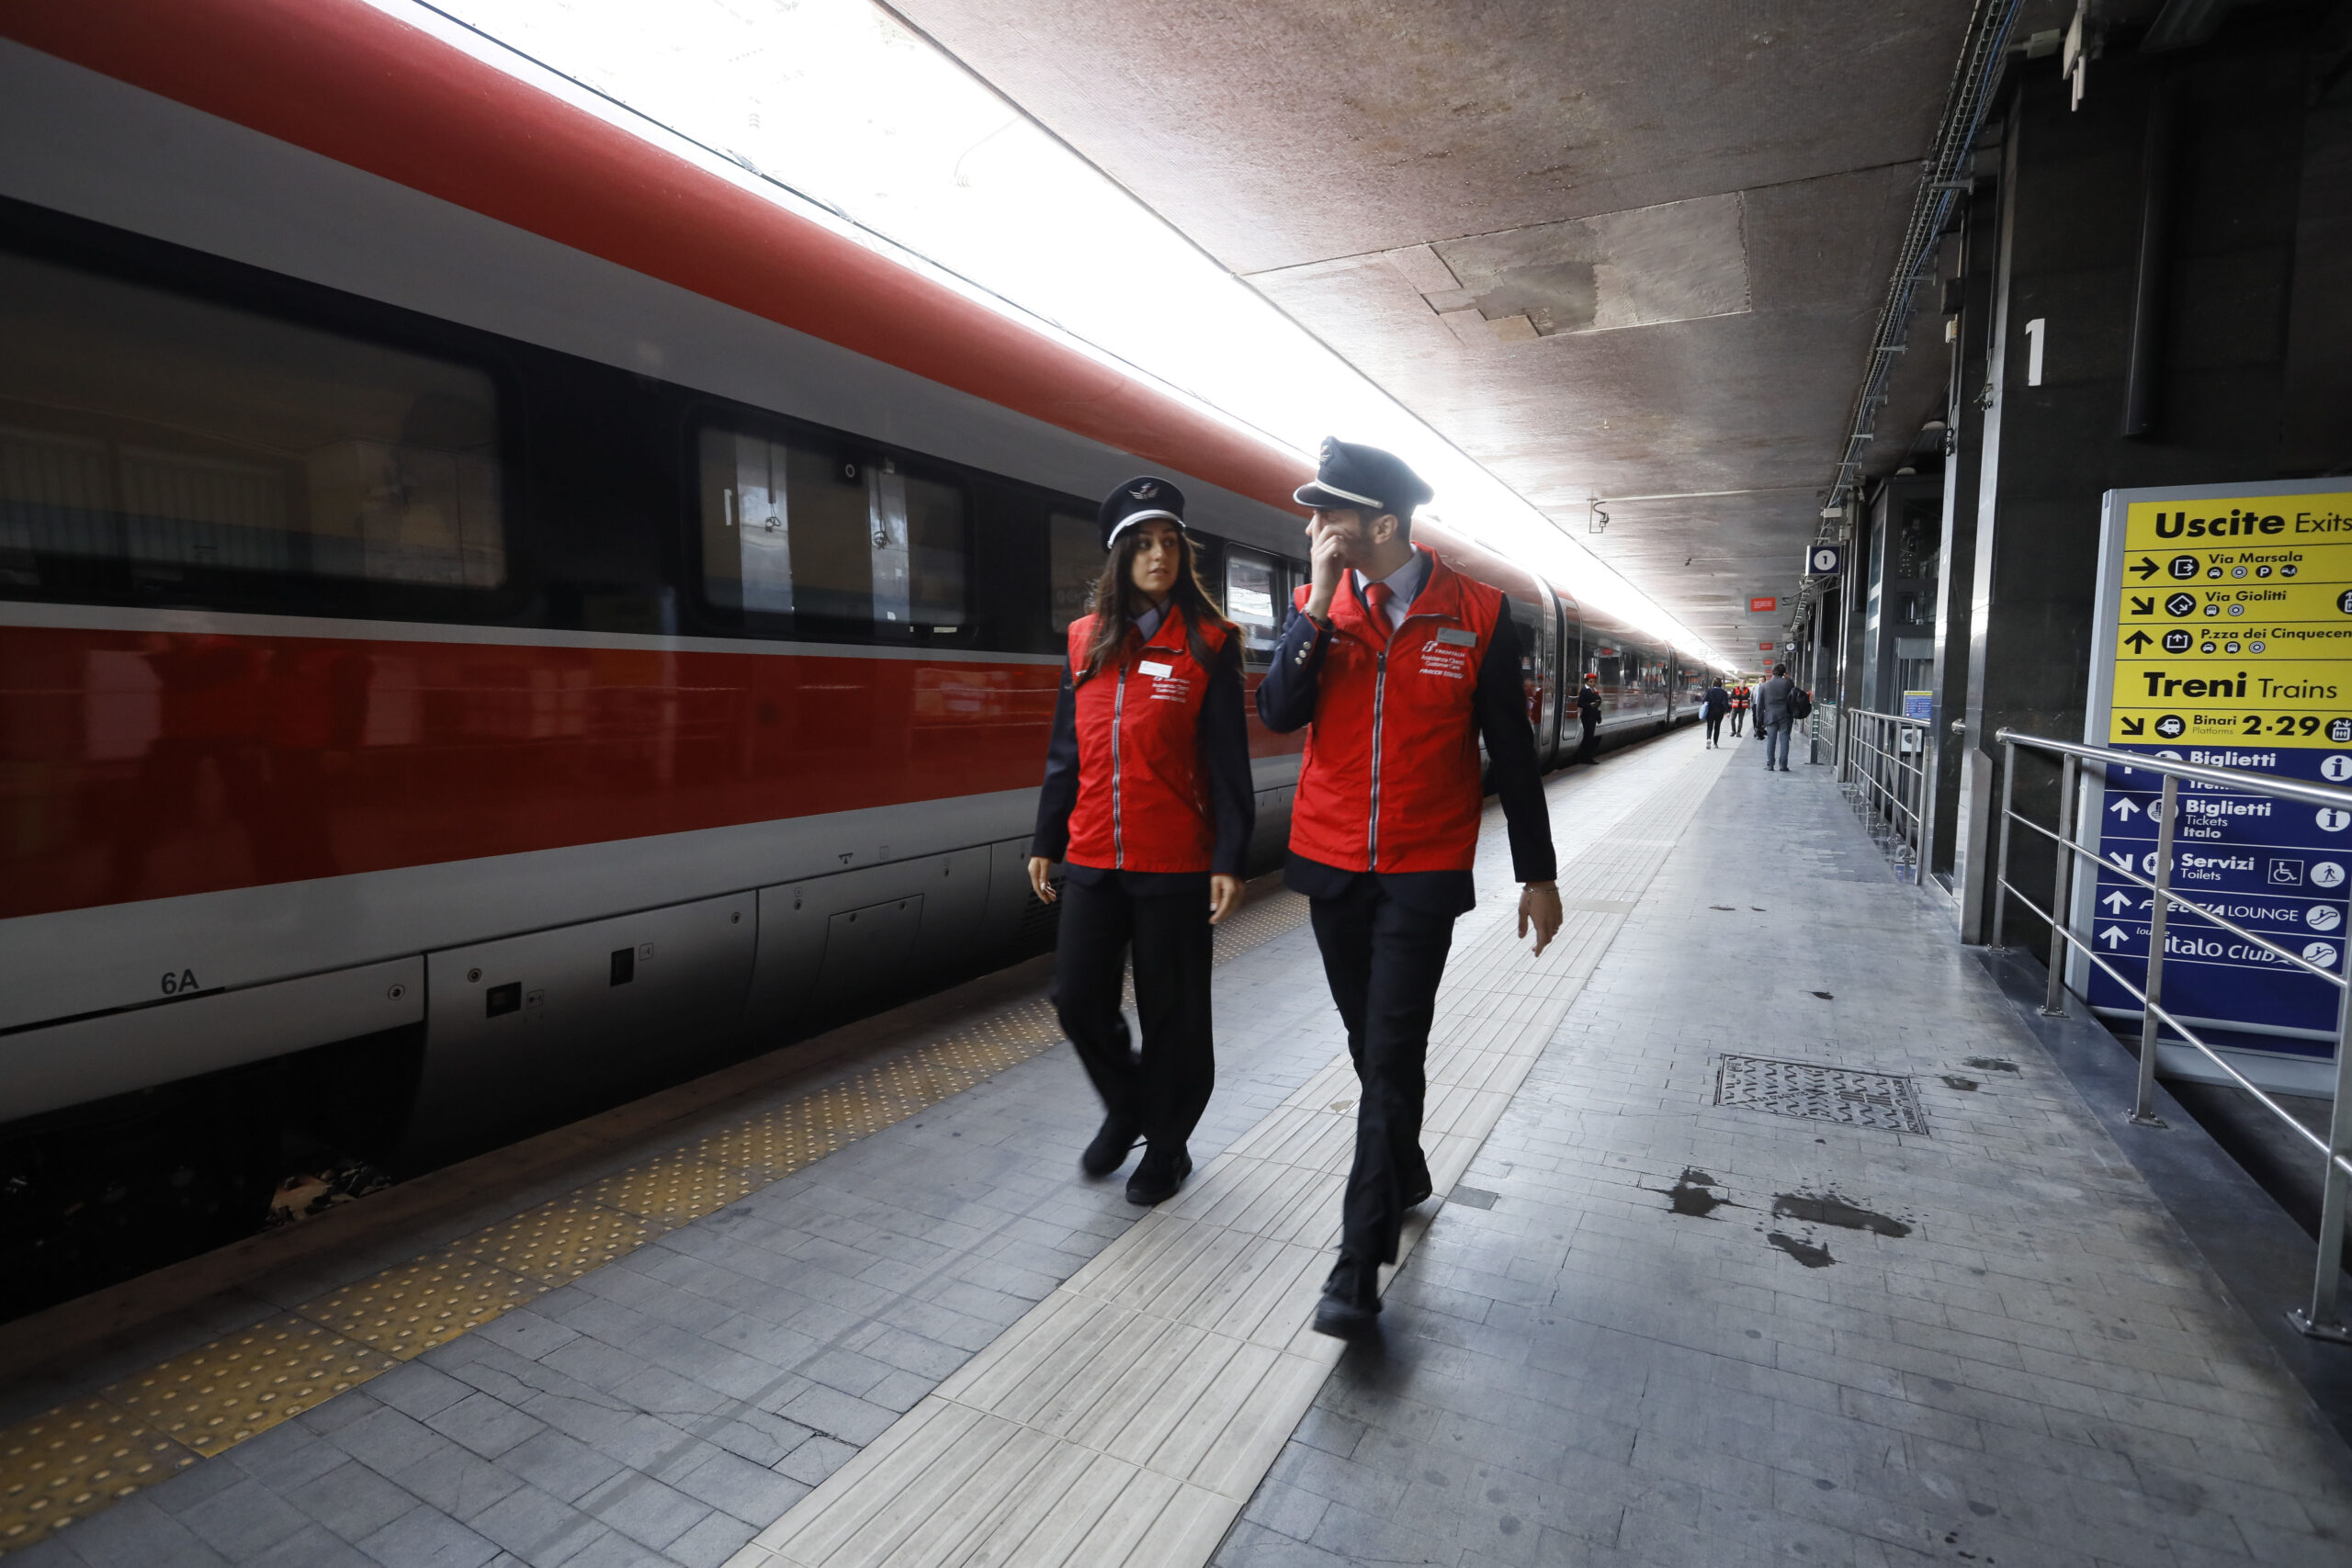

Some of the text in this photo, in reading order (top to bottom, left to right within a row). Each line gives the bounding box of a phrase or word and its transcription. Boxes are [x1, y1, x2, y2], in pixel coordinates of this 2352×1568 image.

[2025, 318, 2045, 387] 1
[2155, 508, 2352, 539] Uscite Exits
[1823, 555, 1828, 565] 1
[2208, 551, 2303, 565] Via Marsala
[2205, 590, 2287, 603] Via Giolitti
[2200, 628, 2239, 640] P.zza
[2243, 628, 2267, 640] dei
[2143, 671, 2338, 699] Treni Trains
[2193, 715, 2237, 726] Binari
[2192, 726, 2234, 736] Platforms
[2189, 750, 2277, 768] Biglietti
[2186, 799, 2272, 818] Biglietti
[2185, 814, 2228, 827] Tickets
[2183, 826, 2222, 840] Italo
[2180, 852, 2256, 871] Servizi
[2179, 867, 2222, 881] Toilets
[2227, 943, 2277, 962] Club
[161, 968, 200, 995] 6A
